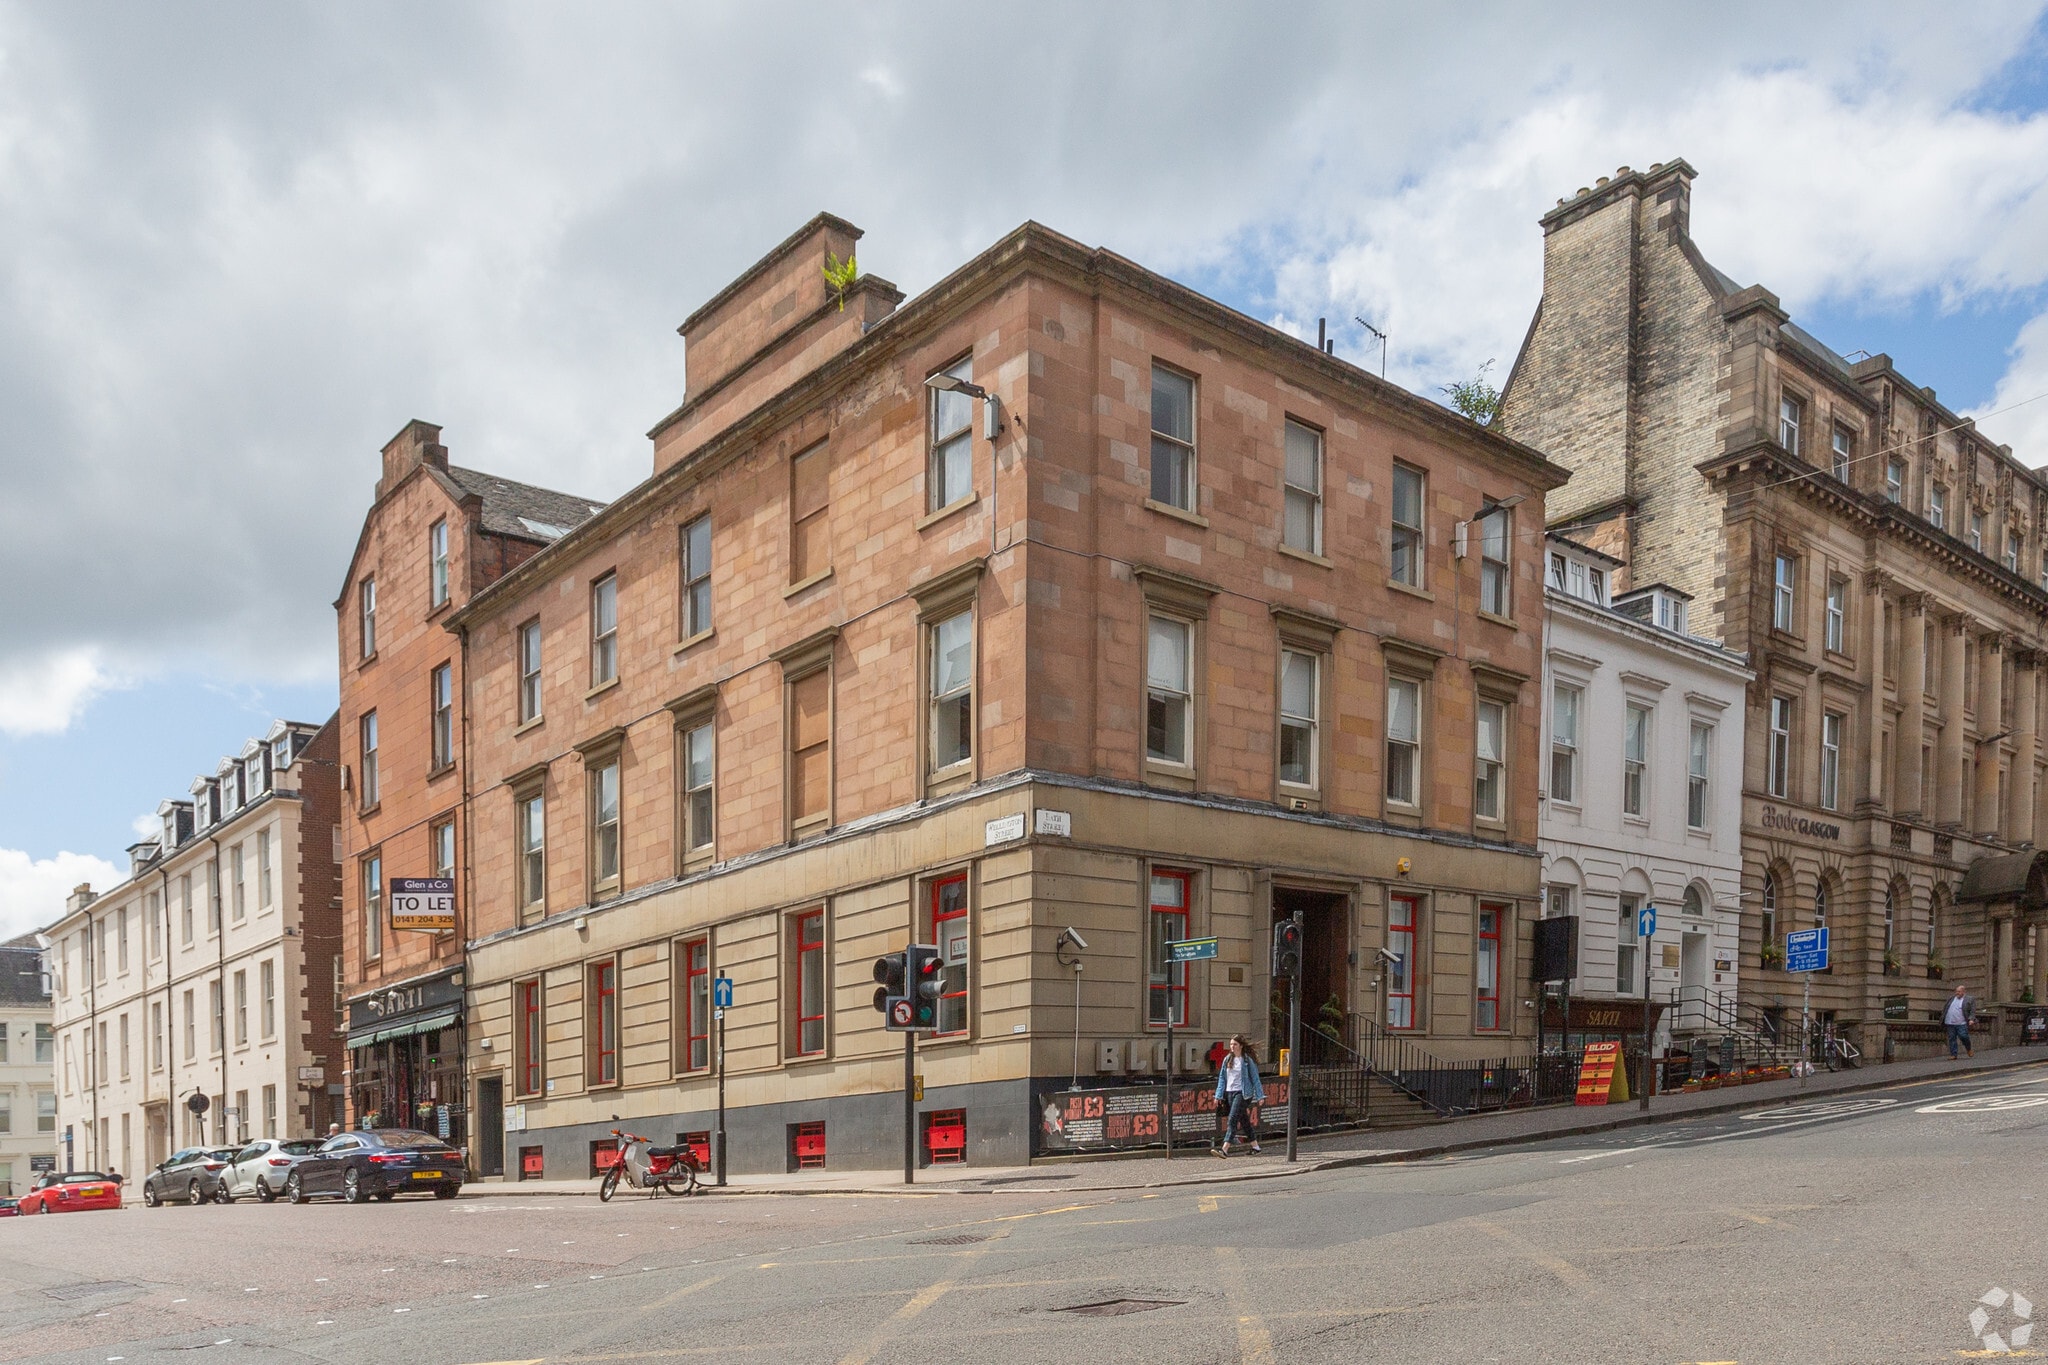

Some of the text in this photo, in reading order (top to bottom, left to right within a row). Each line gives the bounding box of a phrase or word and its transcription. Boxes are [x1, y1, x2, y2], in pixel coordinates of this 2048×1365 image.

[988, 818, 1022, 831] WELLGTON
[1799, 818, 1840, 841] GLASGOW
[404, 880, 426, 888] Glen
[434, 880, 448, 888] Co
[395, 897, 419, 910] TO
[377, 987, 423, 1016] SARTI
[1588, 1010, 1620, 1026] SARTI
[1070, 1098, 1082, 1108] PASTA
[1197, 1090, 1217, 1110] £5
[1084, 1096, 1104, 1118] £3
[1064, 1109, 1082, 1120] MONDAY
[1109, 1115, 1130, 1127] BURGER
[1133, 1114, 1158, 1136] £3
[1107, 1126, 1130, 1138] TUESDAY
